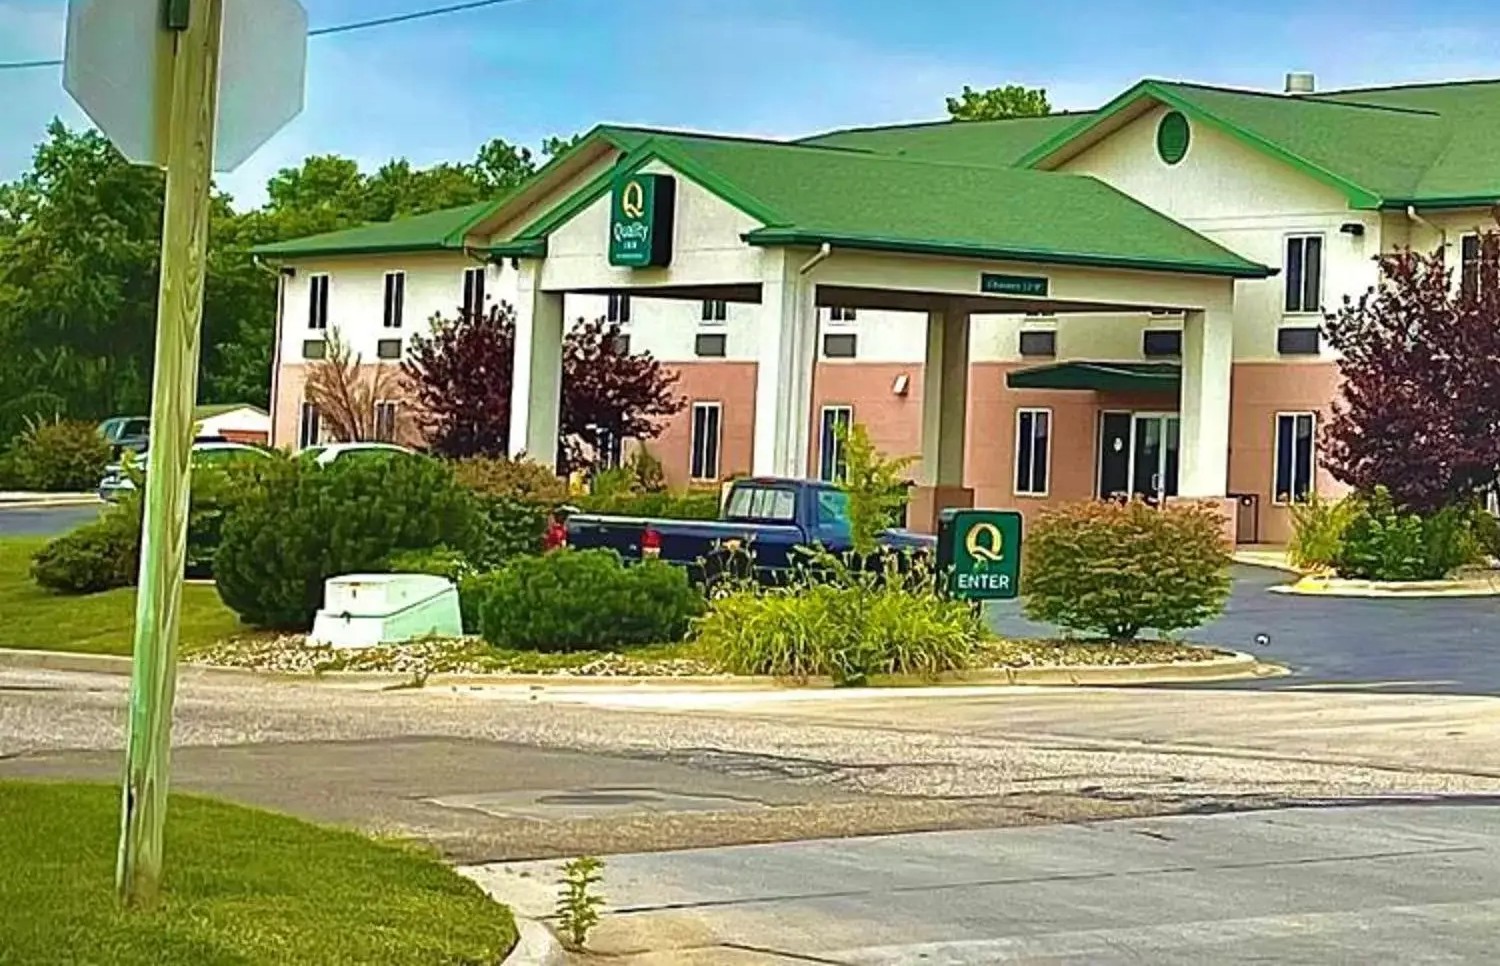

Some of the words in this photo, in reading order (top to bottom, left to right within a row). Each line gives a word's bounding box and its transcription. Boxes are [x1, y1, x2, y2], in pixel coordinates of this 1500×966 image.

[623, 181, 644, 218] Q
[967, 523, 1004, 561] Q
[958, 574, 1009, 589] ENTER
